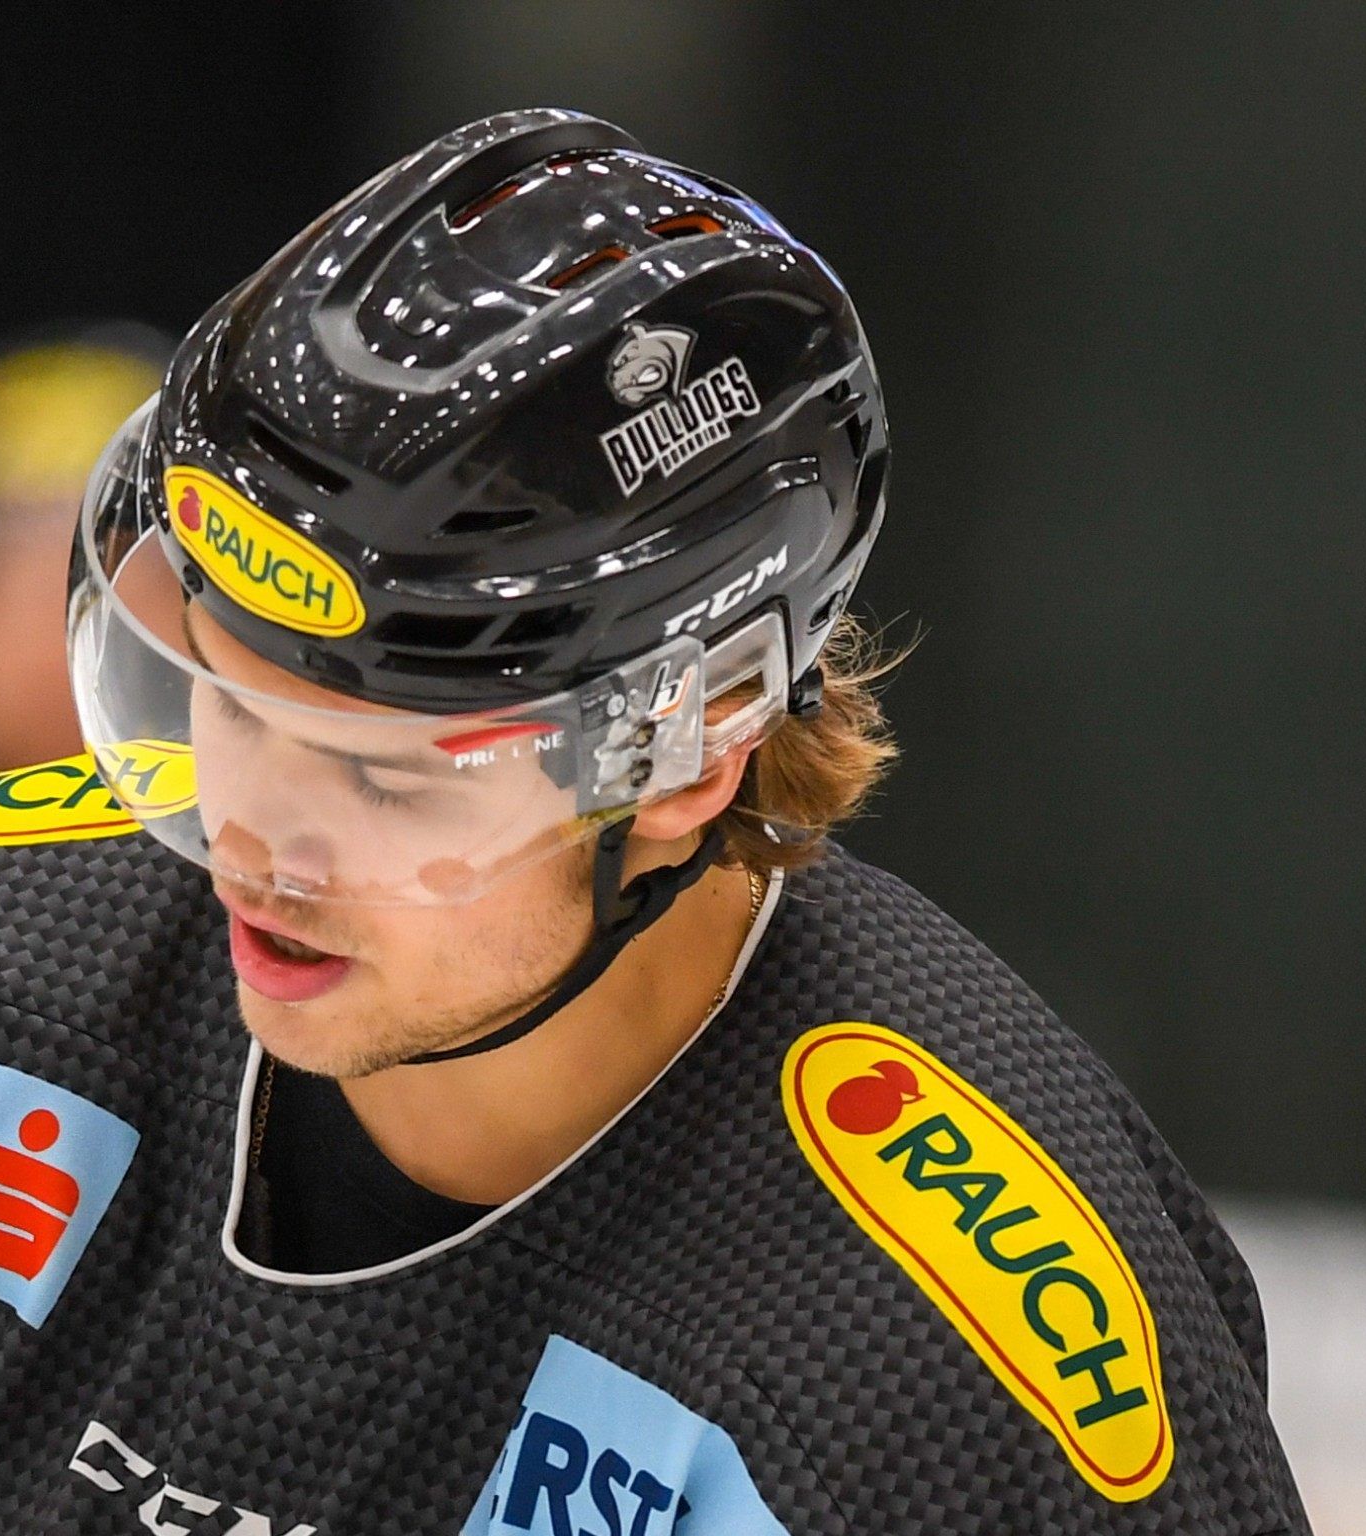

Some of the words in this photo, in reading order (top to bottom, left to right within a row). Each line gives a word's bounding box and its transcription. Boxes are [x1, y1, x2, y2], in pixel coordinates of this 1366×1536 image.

[599, 357, 761, 498] BULLDOGS
[205, 504, 334, 619] RAUCH
[876, 1114, 1149, 1430] RAUCH
